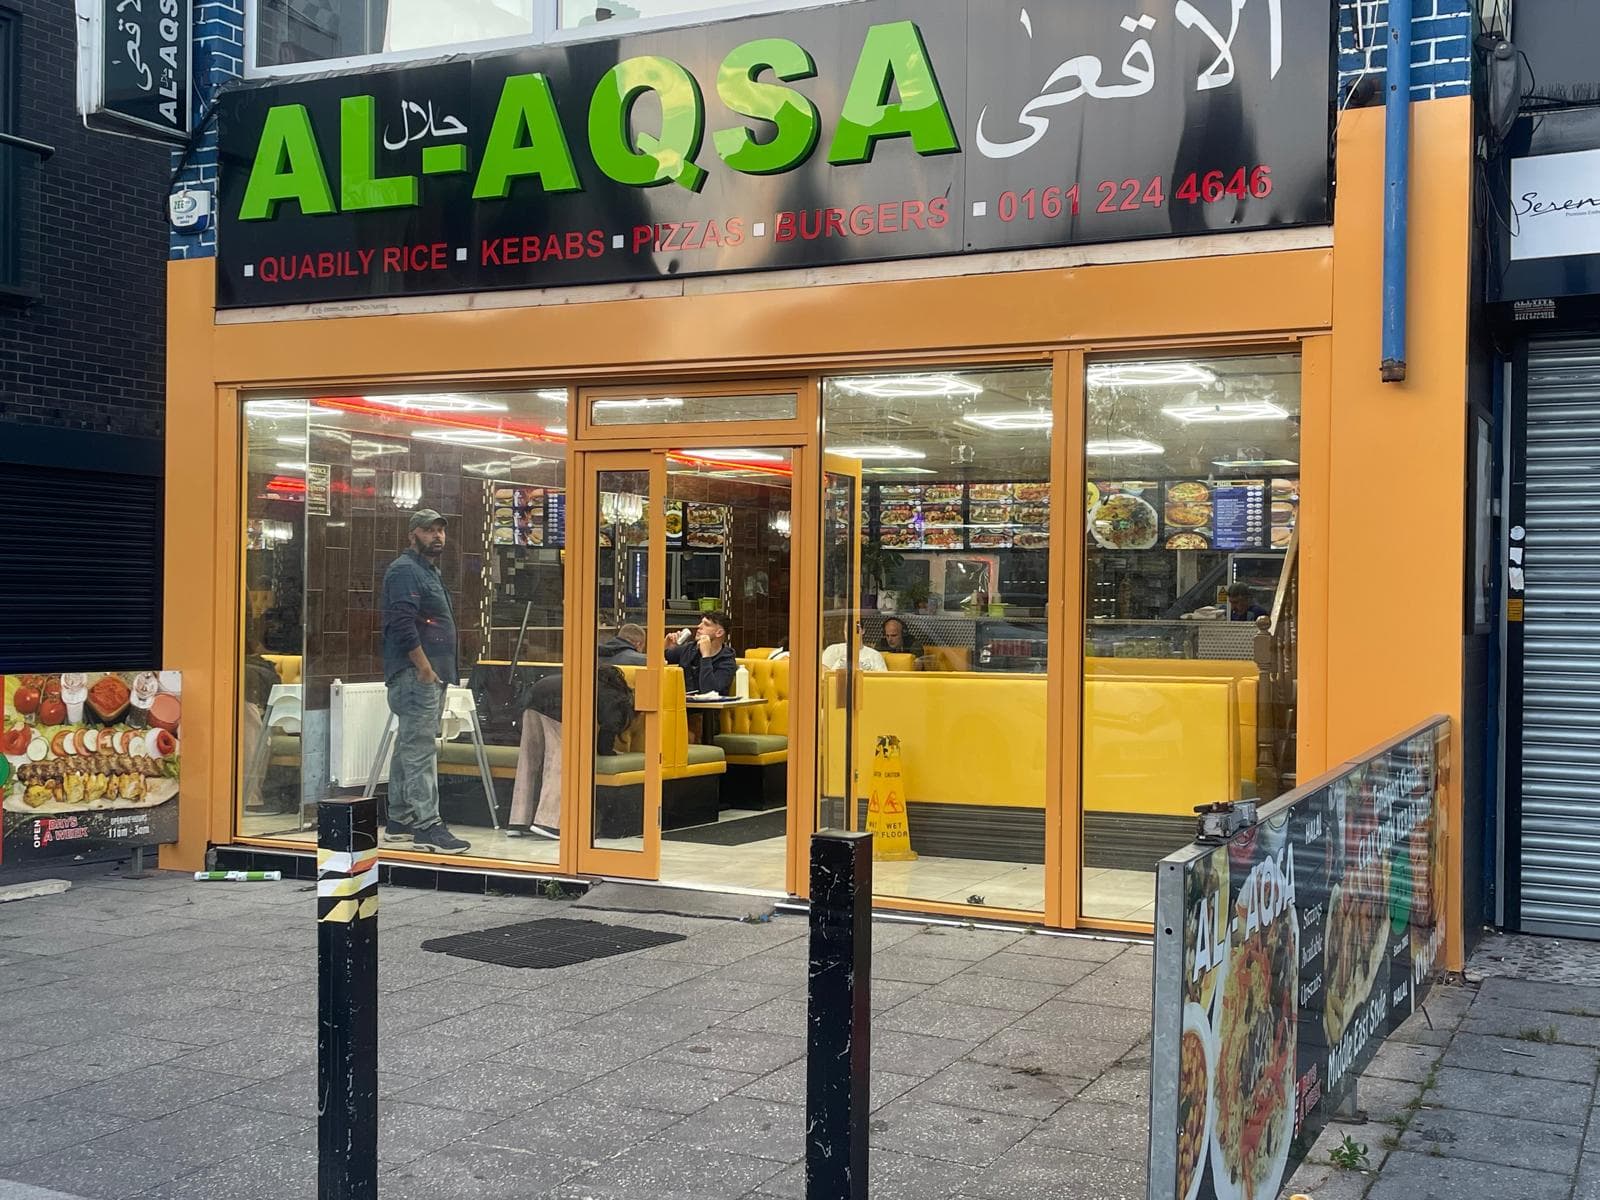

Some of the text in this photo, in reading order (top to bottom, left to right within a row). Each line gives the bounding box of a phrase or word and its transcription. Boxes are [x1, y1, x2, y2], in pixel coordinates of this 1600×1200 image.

[238, 20, 961, 221] AL-AQSA
[383, 99, 467, 150] حلال
[258, 163, 1272, 283] QUABILY RICE KEBABS PIZZAS BURGERS 0161 224 4646
[33, 819, 41, 848] OPEN
[881, 831, 908, 839] FLOOR
[1327, 1027, 1353, 1093] Middle
[1354, 1010, 1369, 1057] East
